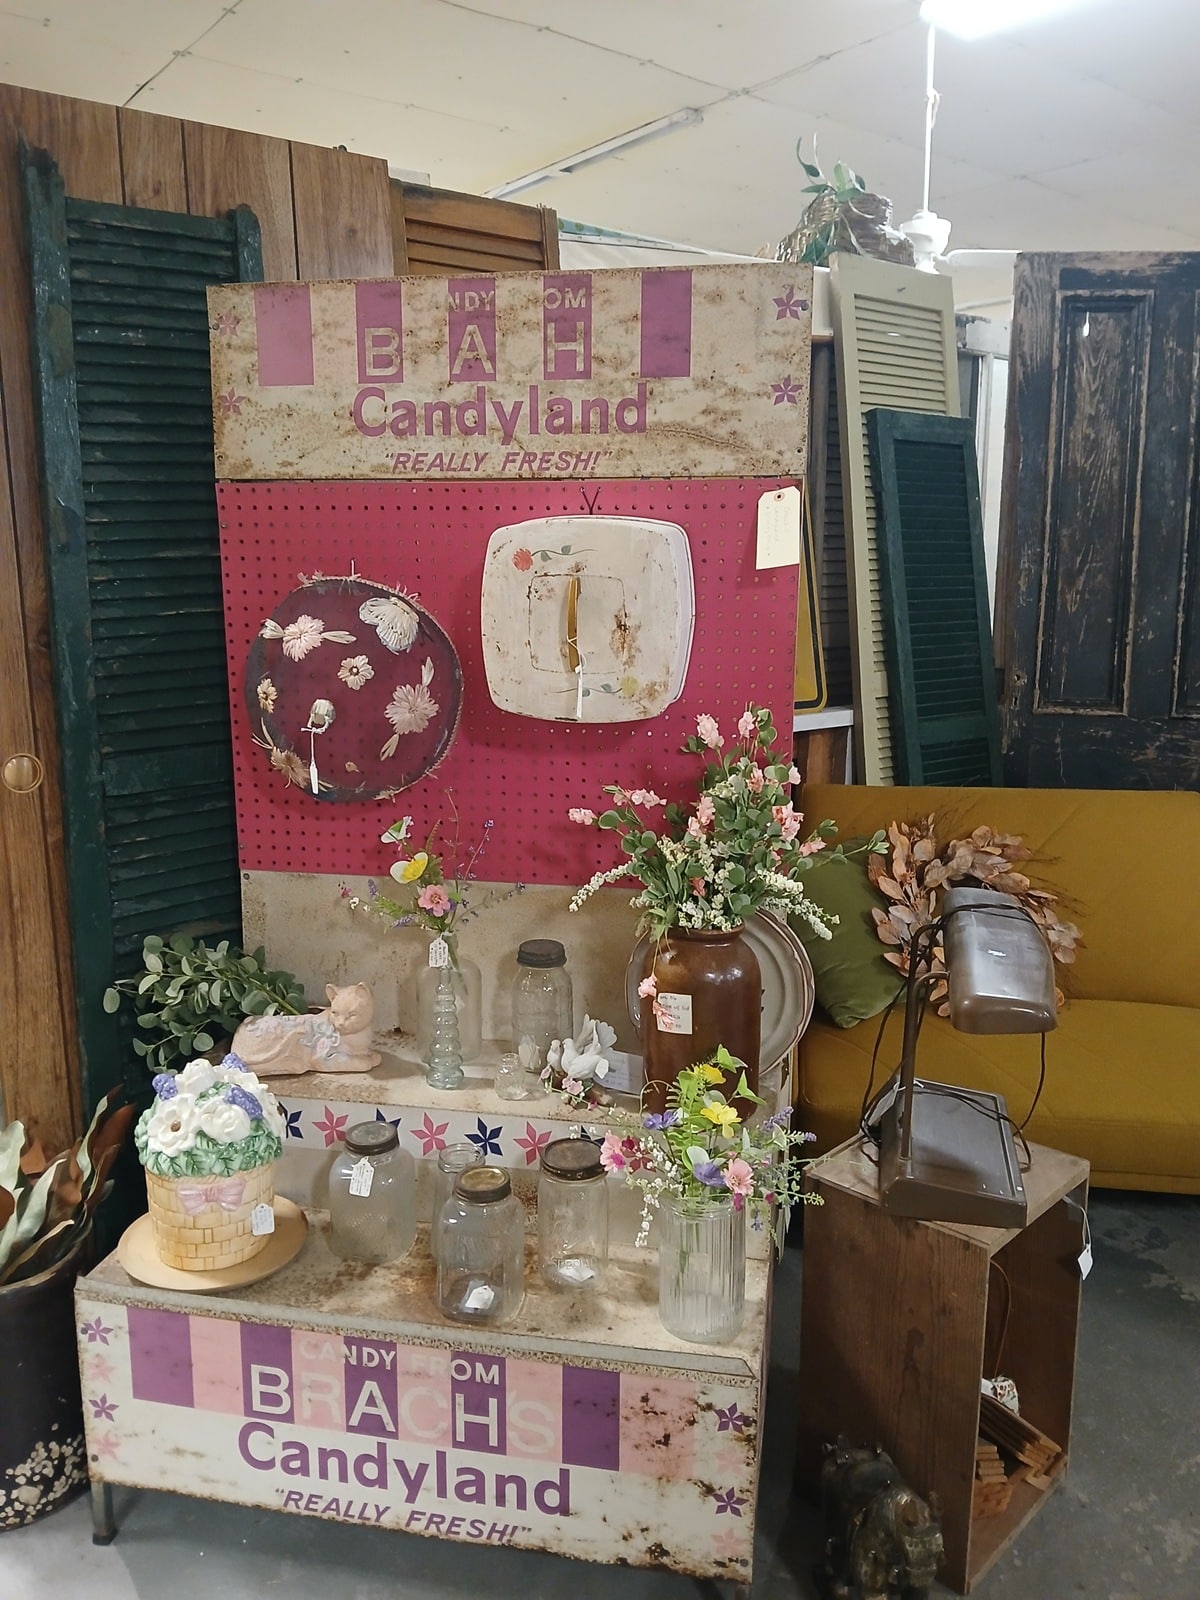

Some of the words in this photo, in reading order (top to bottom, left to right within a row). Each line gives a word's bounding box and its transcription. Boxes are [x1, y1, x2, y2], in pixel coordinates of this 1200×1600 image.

[352, 383, 647, 446] Candyland
[300, 1338, 396, 1371] CANDY
[411, 1353, 500, 1386] FROM
[238, 1421, 570, 1517] Candyland
